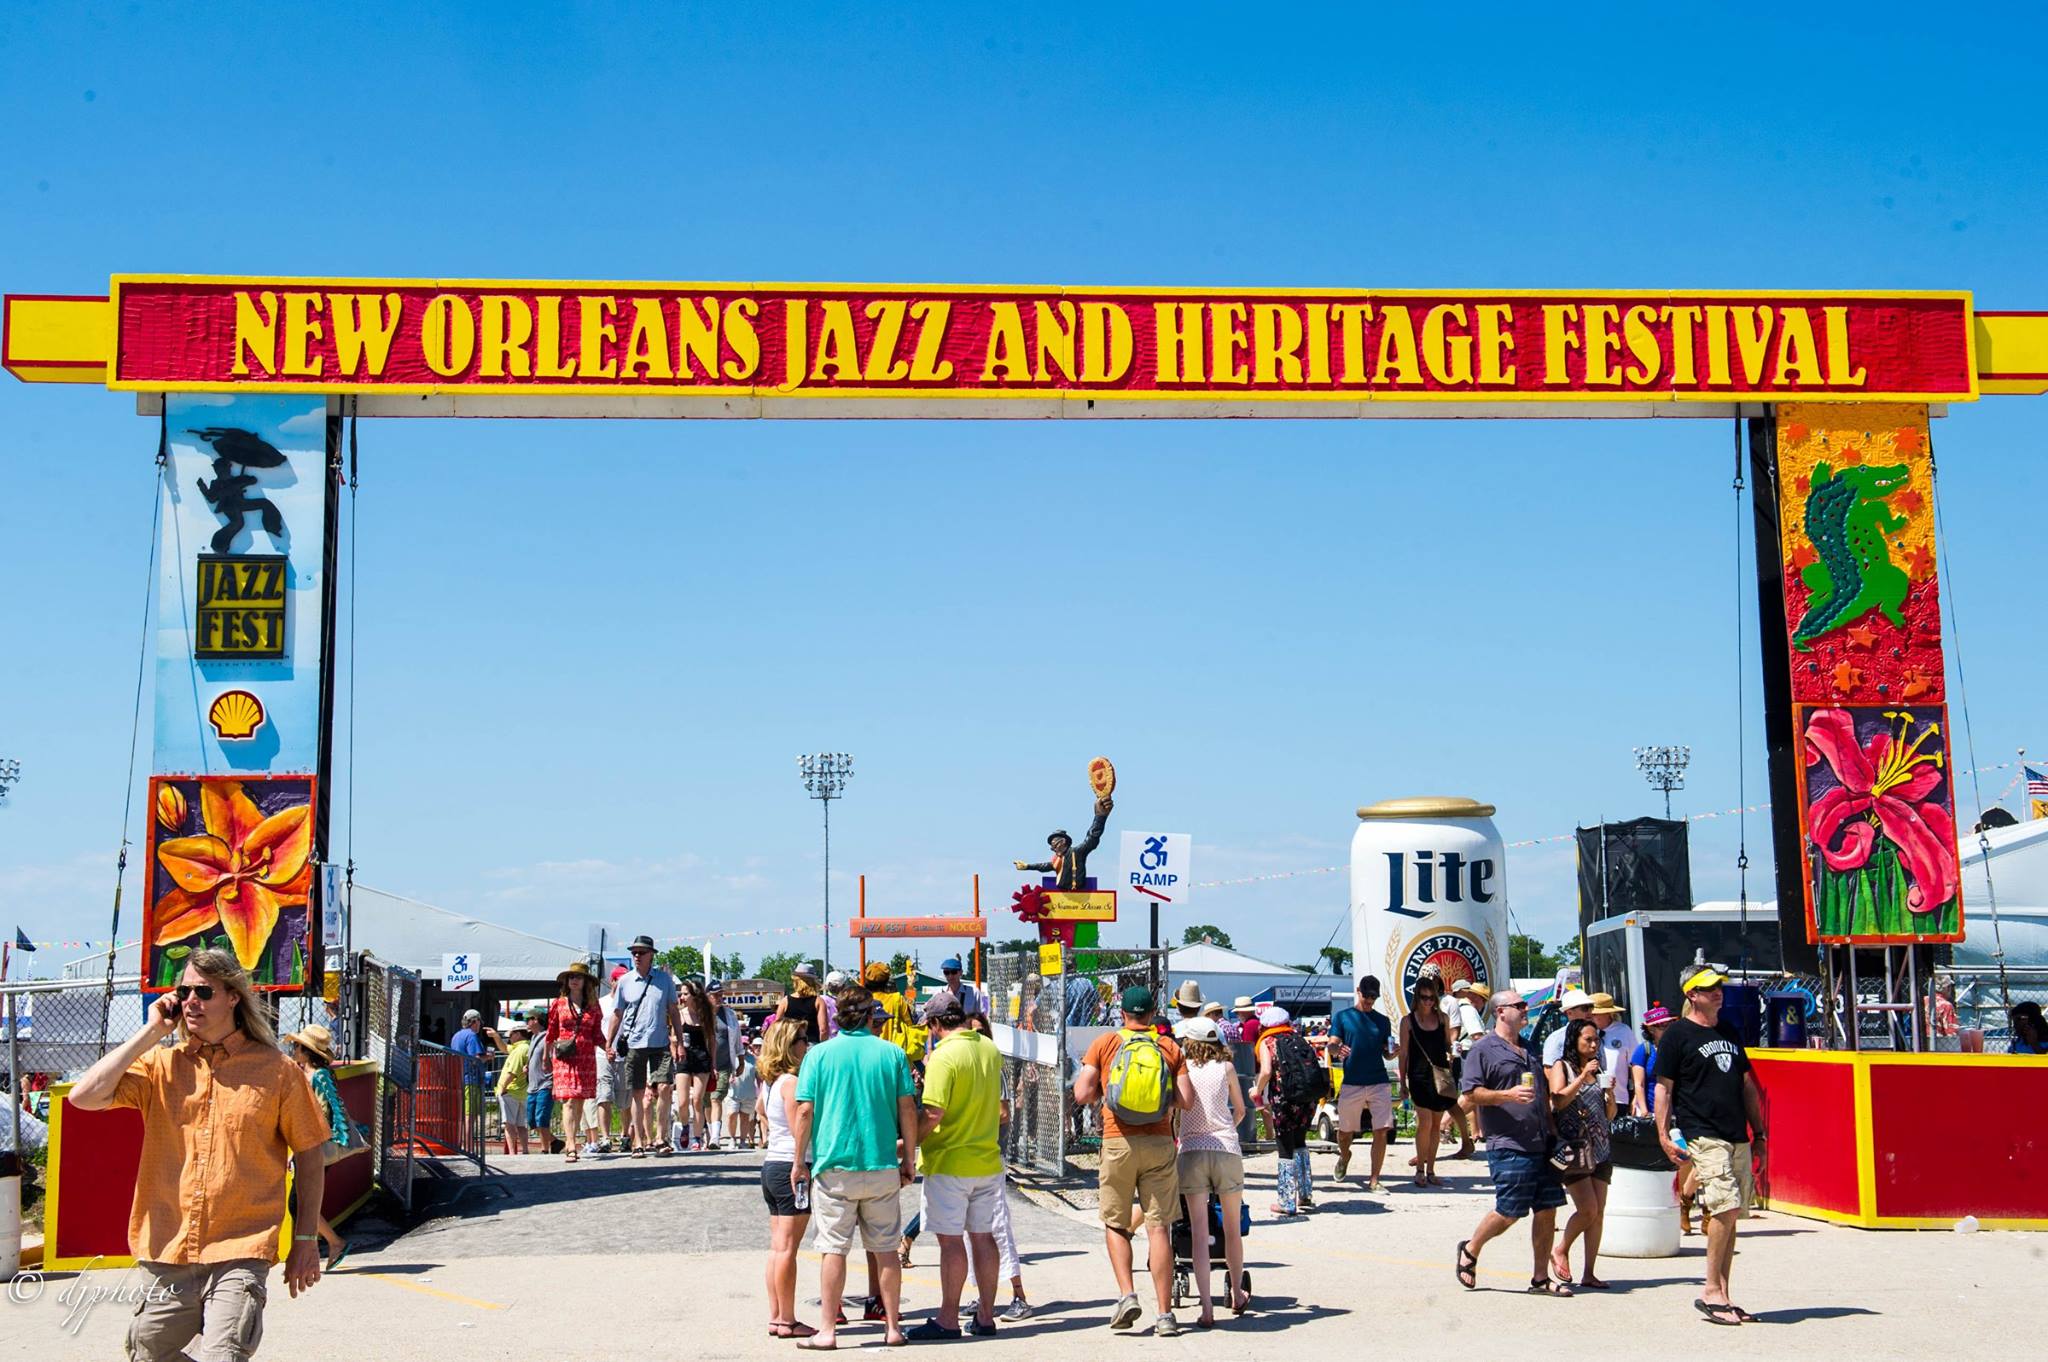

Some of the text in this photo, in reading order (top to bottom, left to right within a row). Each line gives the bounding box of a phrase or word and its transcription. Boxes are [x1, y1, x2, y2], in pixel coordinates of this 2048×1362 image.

[232, 291, 1866, 392] NEW ORLEANS JAZZ AND HERITAGE FESTIVAL
[200, 564, 283, 607] JAZZ
[200, 610, 284, 649] FEST
[1130, 872, 1178, 886] RAMP
[1382, 850, 1495, 919] Lite
[949, 922, 982, 932] NOCCA
[447, 974, 474, 982] RAMP
[1405, 937, 1488, 995] A FINE PILSNE
[722, 995, 763, 1005] CHAIRS
[1698, 1040, 1739, 1058] BROOKLYN
